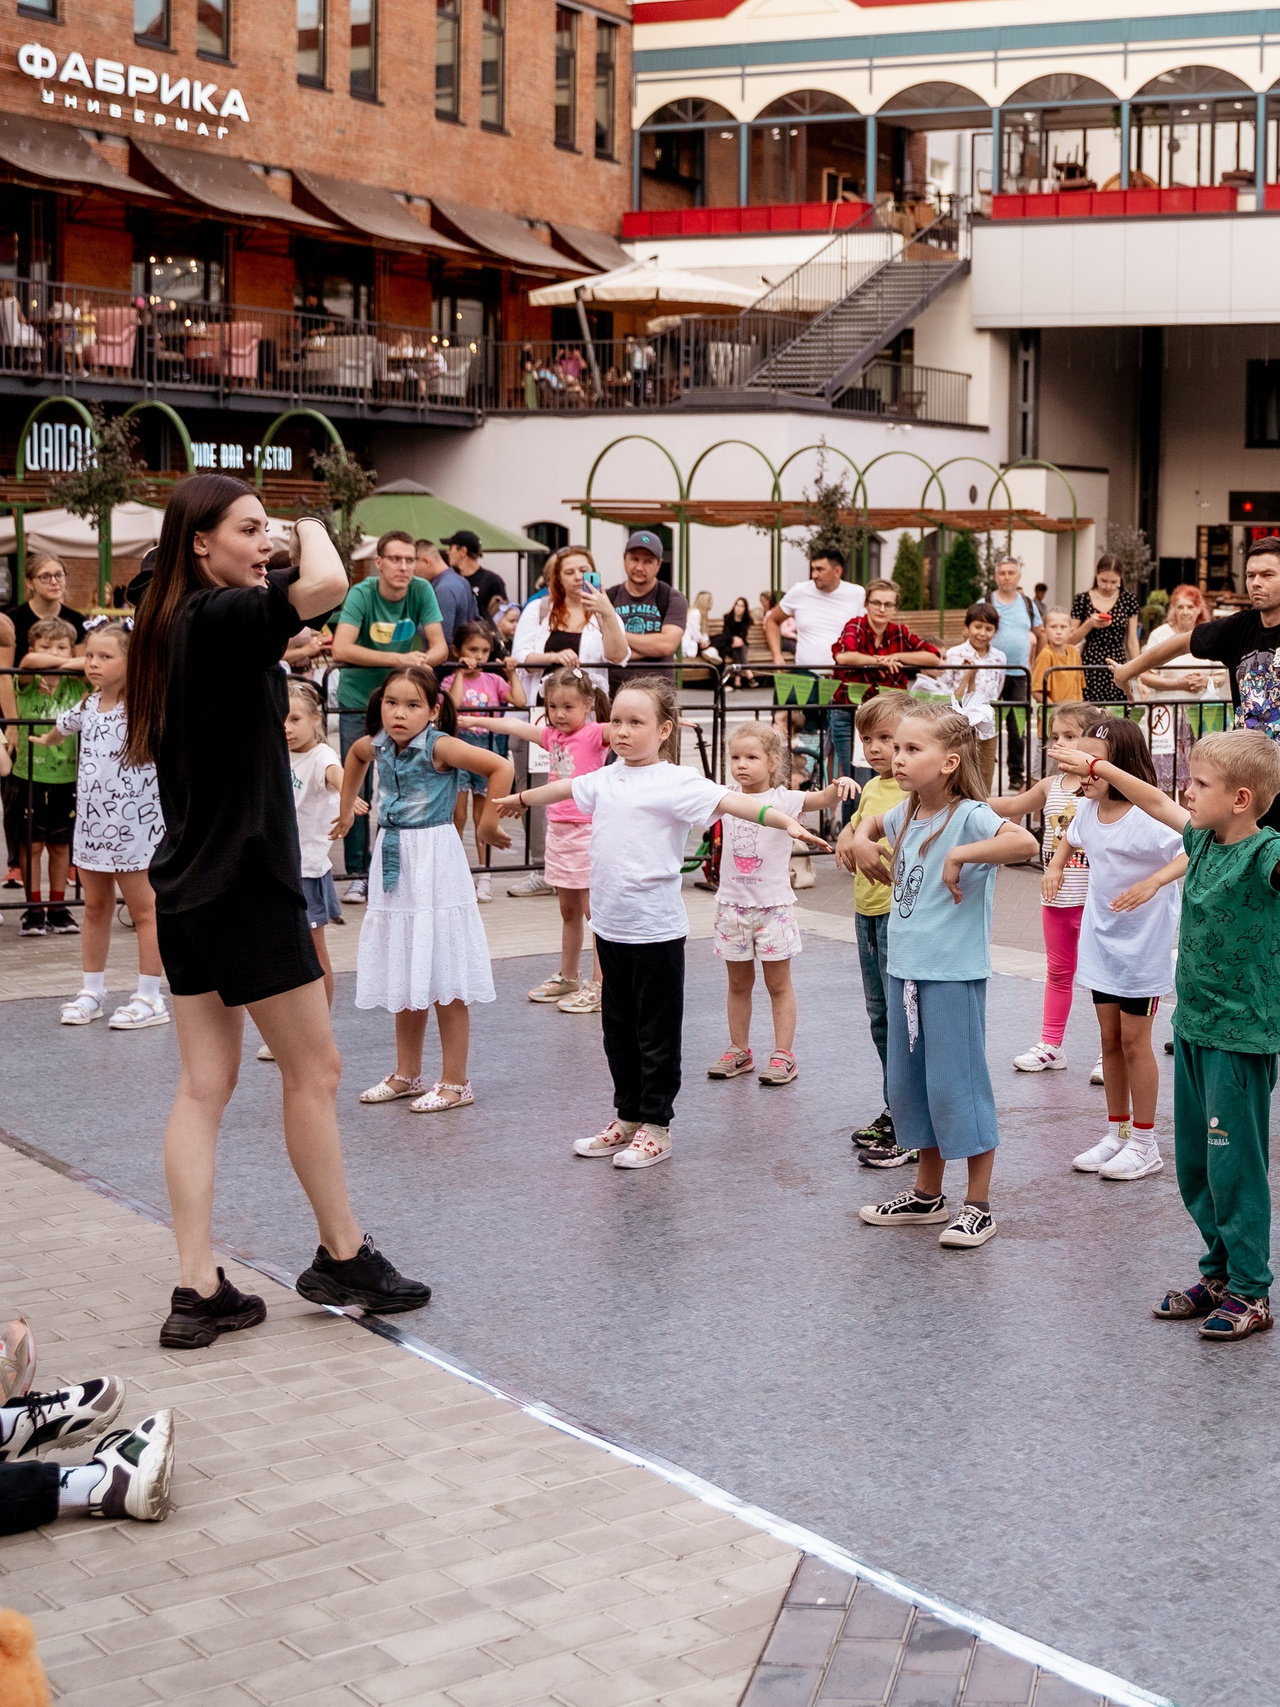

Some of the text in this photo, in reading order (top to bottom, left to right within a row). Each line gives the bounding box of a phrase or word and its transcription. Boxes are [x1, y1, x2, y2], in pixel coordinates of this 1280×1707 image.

[17, 42, 250, 123] ФАБРИКА
[42, 88, 229, 140] УНИВЕРМАГ
[220, 443, 245, 469] BAR
[253, 444, 292, 471] BSTRO
[614, 604, 630, 614] OM
[85, 841, 127, 852] MARC
